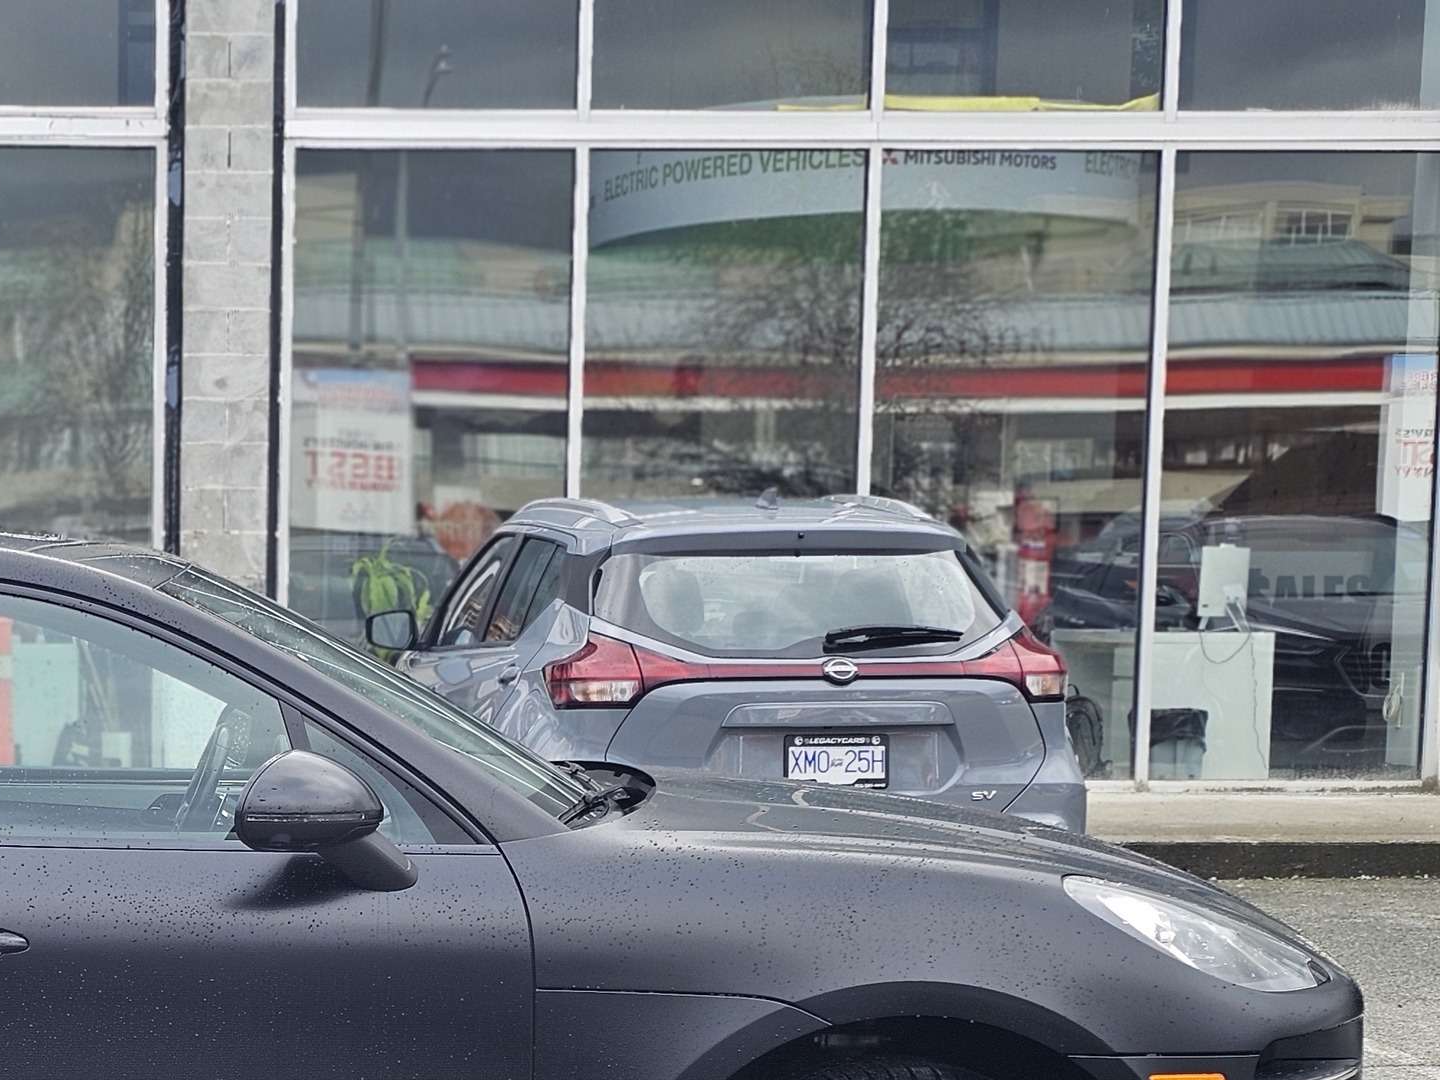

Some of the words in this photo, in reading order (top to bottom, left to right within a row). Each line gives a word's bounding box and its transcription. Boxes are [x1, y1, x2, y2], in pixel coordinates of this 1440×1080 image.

[903, 150, 996, 167] MITSUBISHI
[1000, 153, 1057, 171] MOTORS
[604, 167, 658, 201] ELECTRIC
[662, 152, 753, 188] POWERED
[759, 150, 866, 174] VEHICLES
[845, 750, 885, 773] 25H
[971, 790, 997, 801] SV
